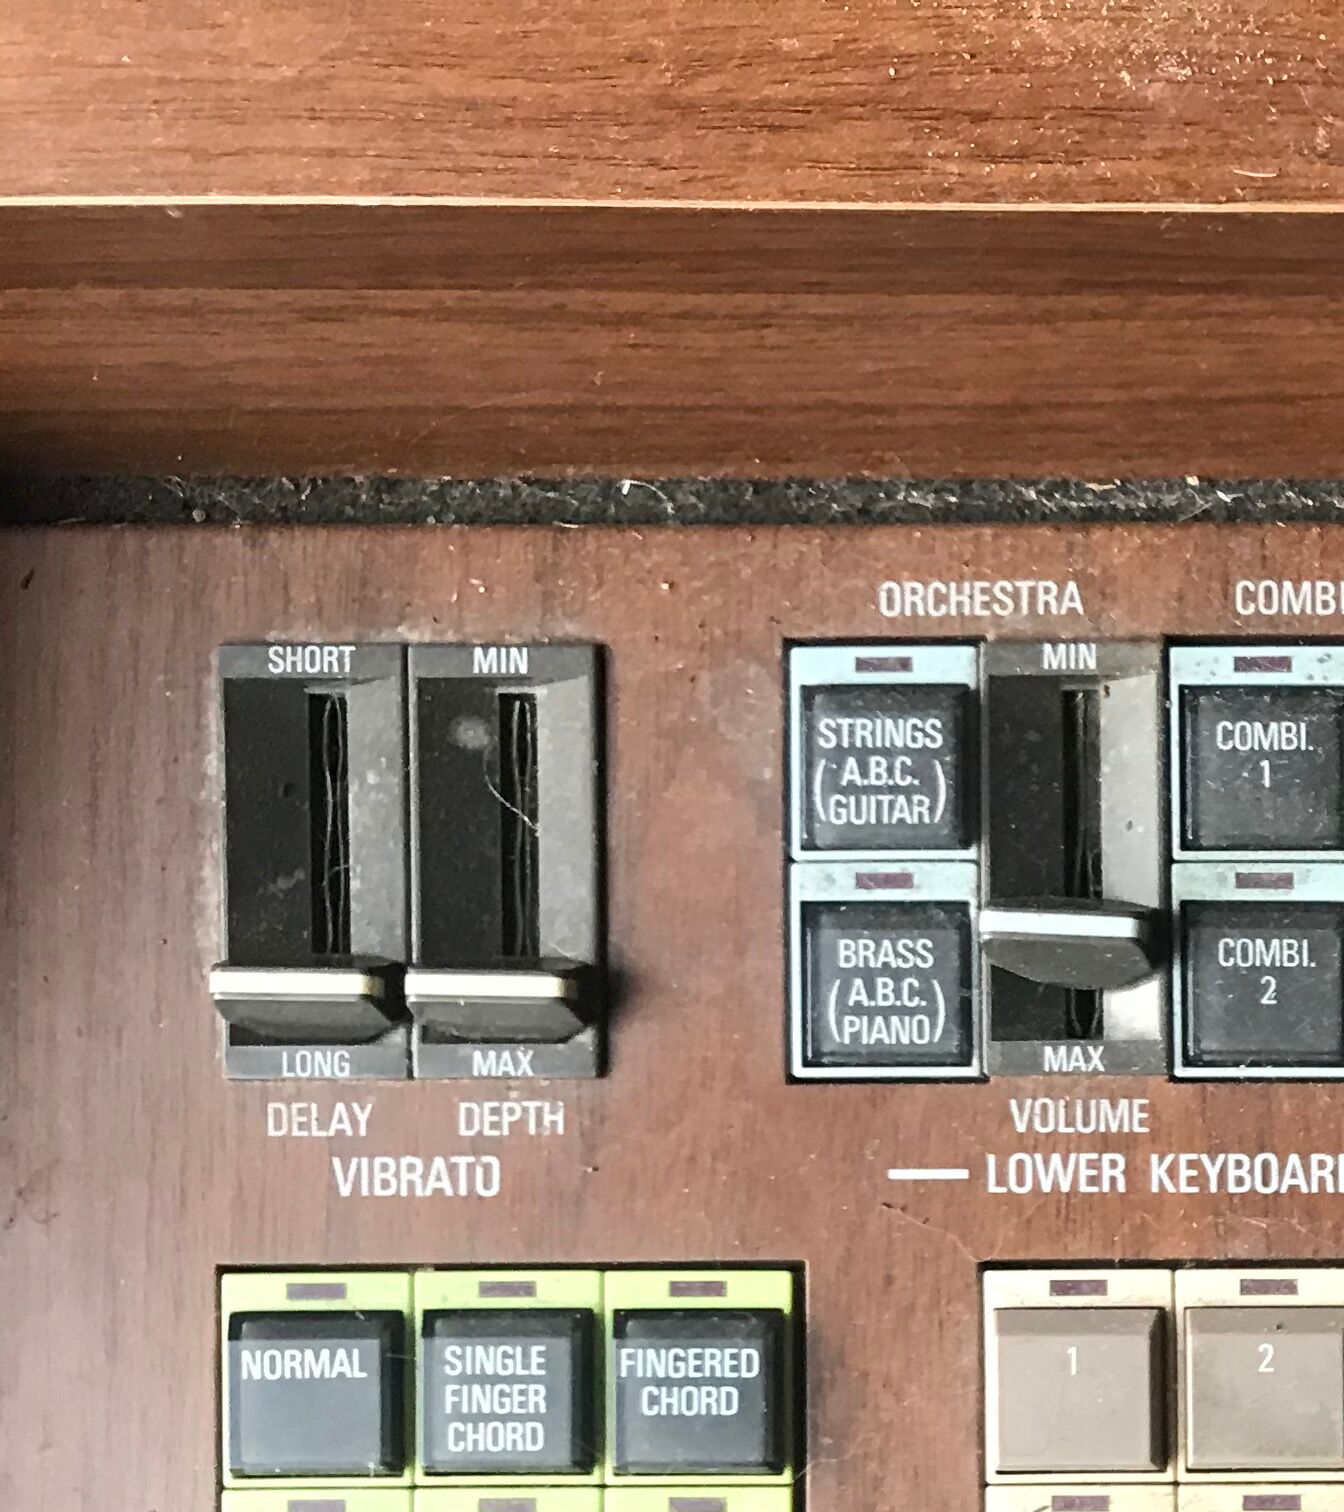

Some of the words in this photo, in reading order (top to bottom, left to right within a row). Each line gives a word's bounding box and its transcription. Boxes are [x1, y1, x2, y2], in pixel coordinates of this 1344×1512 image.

[878, 579, 1084, 618] ORCHESTRA
[267, 645, 356, 675] SHORT
[472, 646, 529, 675] MIN
[1042, 643, 1097, 670] MIN
[816, 716, 943, 749] STRINGS
[1215, 720, 1314, 752] COMBI.
[1259, 759, 1271, 788] 1
[837, 938, 934, 969] BRASS
[1218, 937, 1316, 968] COMBI.
[1260, 975, 1277, 1005] 2
[281, 1049, 351, 1079] LONG
[472, 1049, 534, 1077] MAX
[1043, 1045, 1105, 1072] MAX
[267, 1102, 373, 1137] DELAY
[458, 1100, 564, 1137] DEPTH
[1009, 1097, 1150, 1134] VOLUME
[332, 1155, 501, 1197] VIBRATO
[986, 1152, 1126, 1194] LOWER
[241, 1348, 368, 1381] NORMAL
[443, 1344, 546, 1377] SINGLE
[619, 1347, 760, 1379] FINGERED
[1066, 1346, 1077, 1376] 1
[1257, 1342, 1275, 1373] 2
[444, 1383, 547, 1415] FINGER
[639, 1385, 739, 1417] CHORD
[447, 1421, 544, 1453] CHORD
